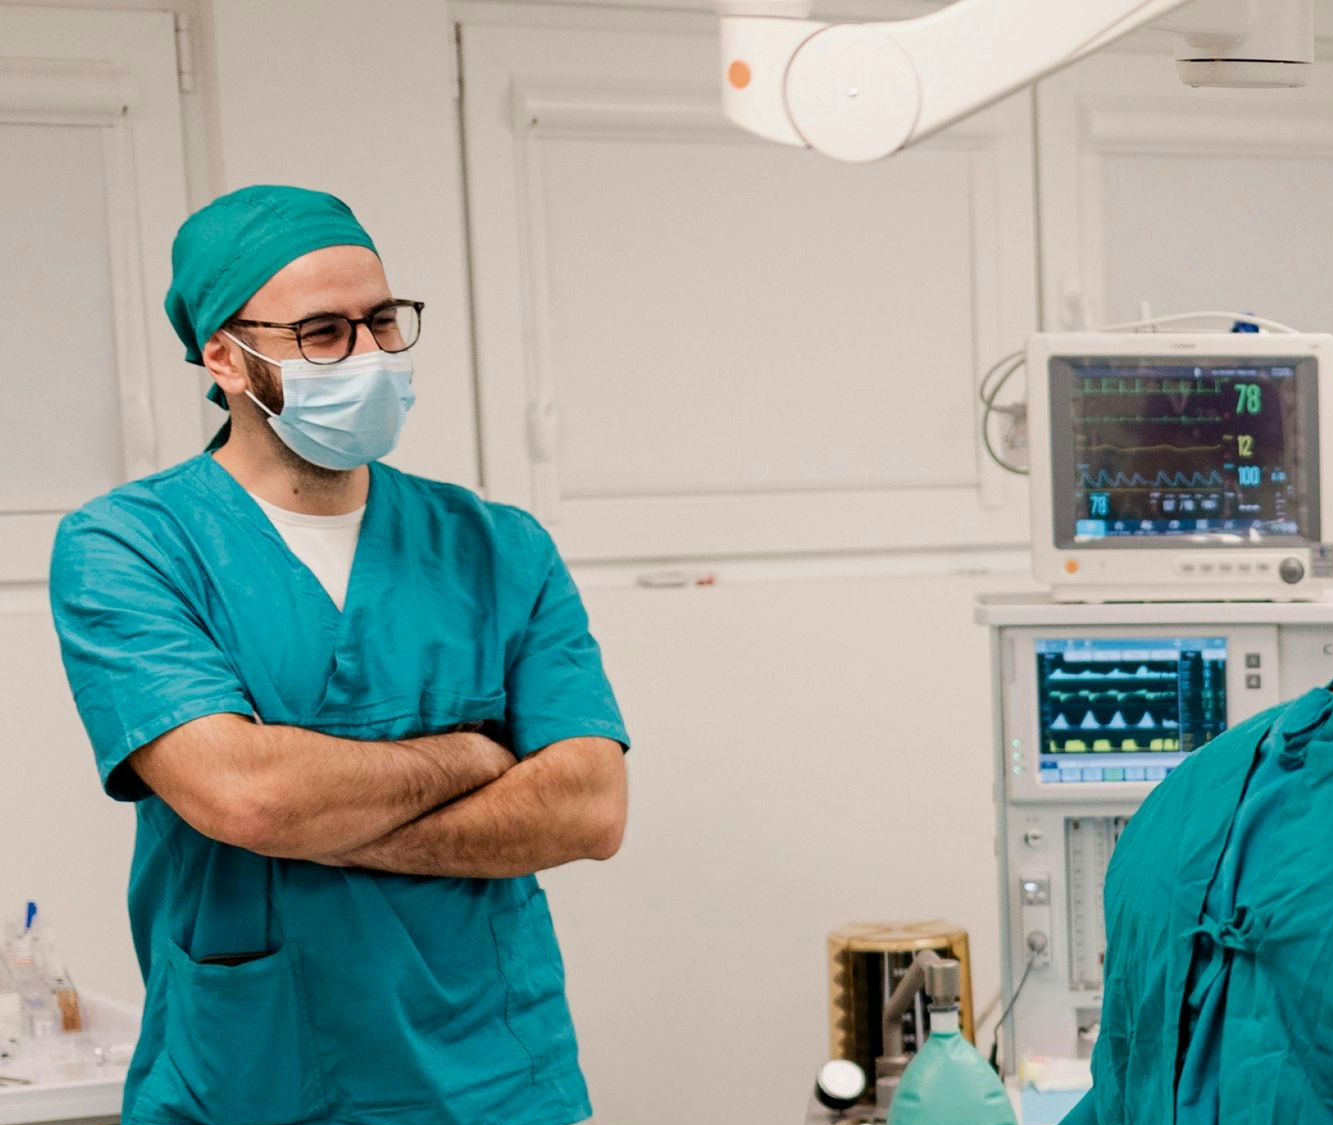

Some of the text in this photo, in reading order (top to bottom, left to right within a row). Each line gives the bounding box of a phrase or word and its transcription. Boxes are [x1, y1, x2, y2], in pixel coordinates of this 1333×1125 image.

[1233, 383, 1262, 415] 78
[1236, 434, 1254, 458] 12
[1237, 465, 1262, 487] 100
